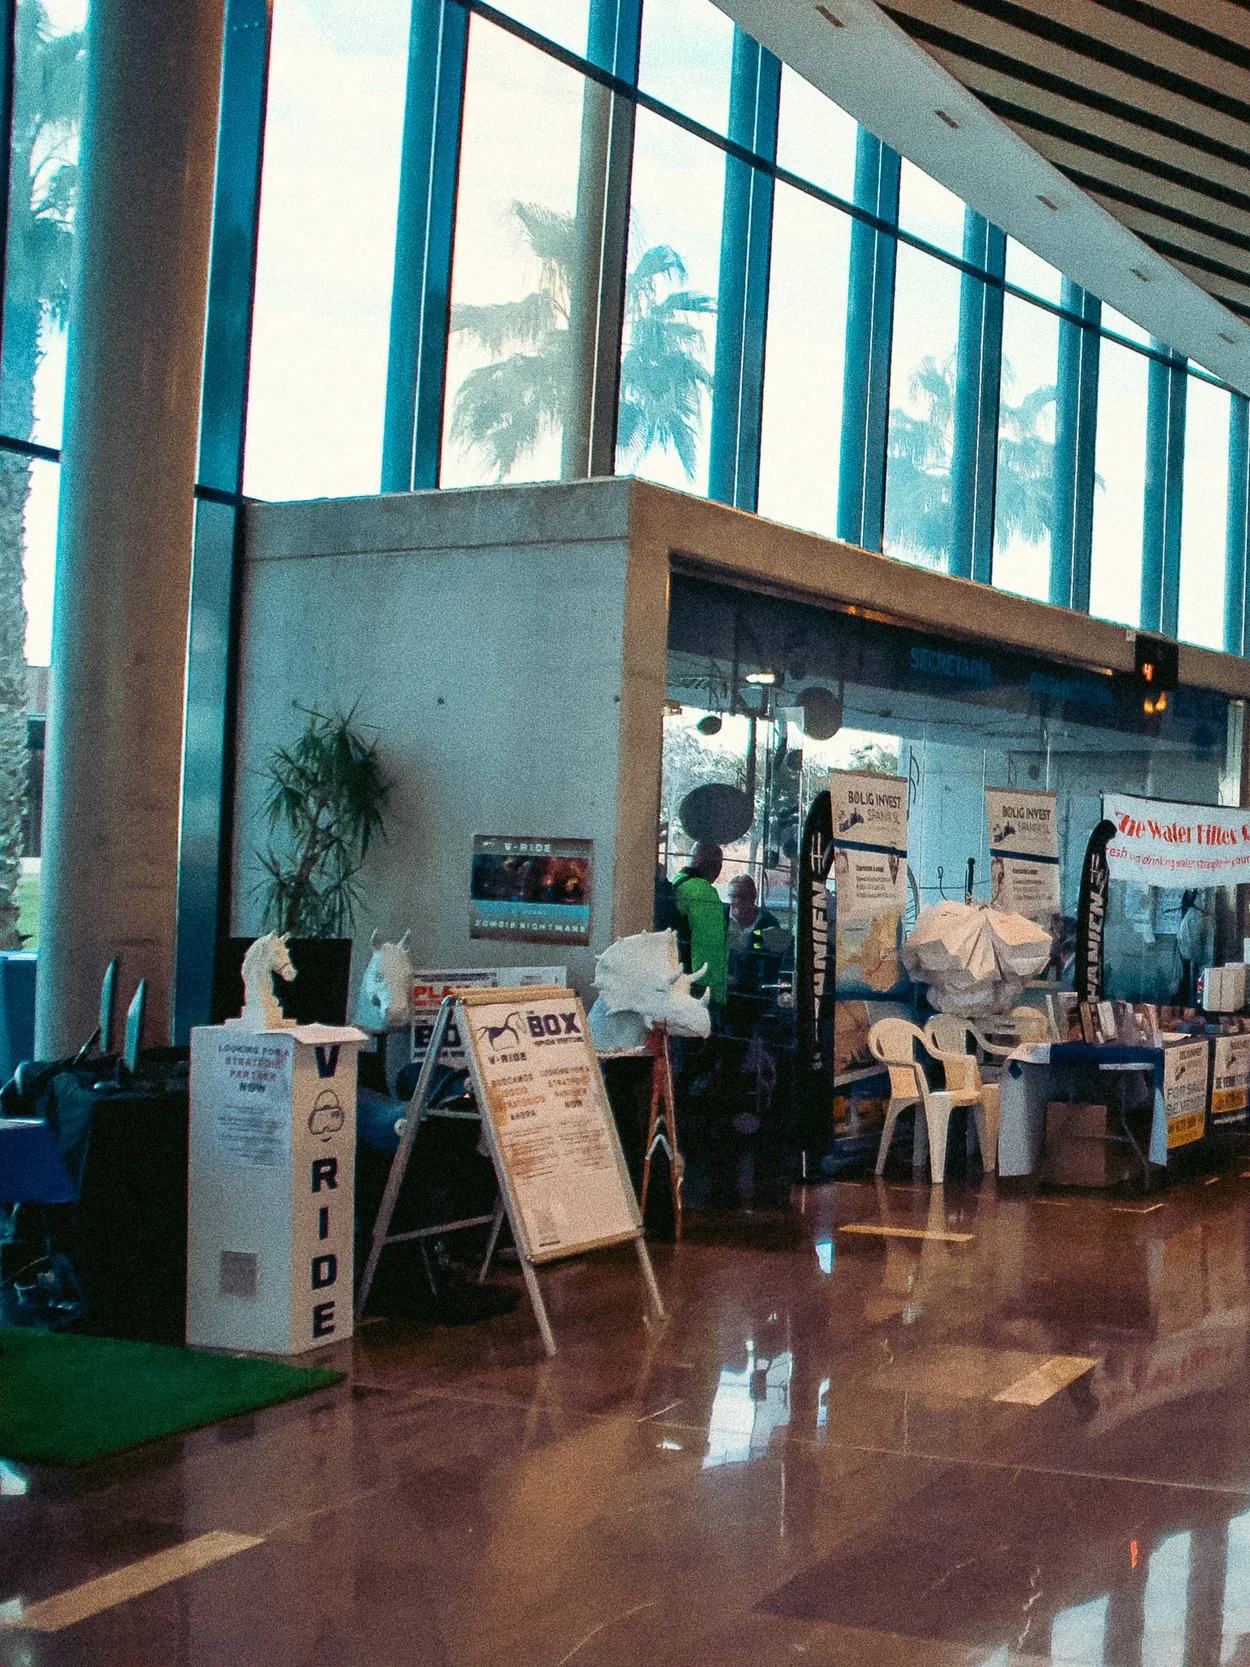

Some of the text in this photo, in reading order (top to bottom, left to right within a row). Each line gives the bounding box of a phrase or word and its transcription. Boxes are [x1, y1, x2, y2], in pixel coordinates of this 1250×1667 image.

[848, 790, 902, 809] BOLIG INVEST
[1002, 805, 1051, 821] BOLIG INVEST
[1115, 811, 1146, 839] The
[1147, 818, 1192, 845] Water
[1196, 822, 1238, 846] Filter
[520, 922, 587, 934] NIGHTMARE
[527, 1012, 582, 1038] BOX
[218, 1044, 260, 1056] LOOKING
[488, 1051, 528, 1065] V-RIDE
[311, 1157, 340, 1339] RIDE
